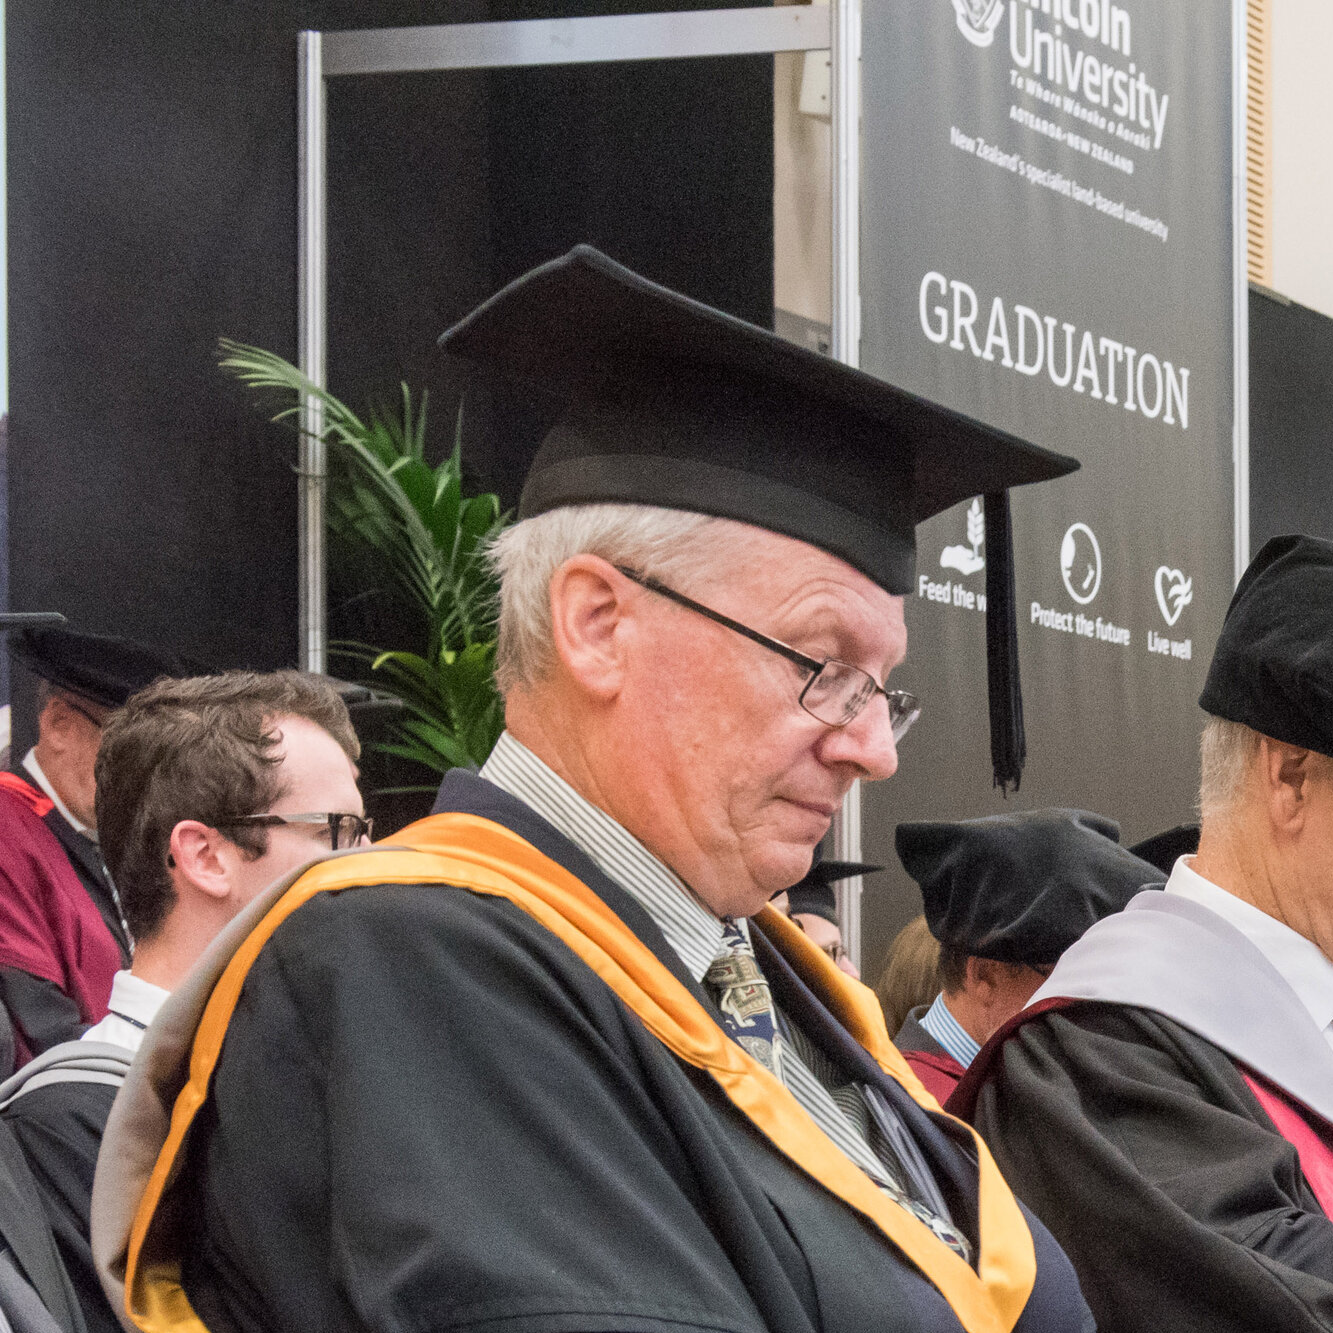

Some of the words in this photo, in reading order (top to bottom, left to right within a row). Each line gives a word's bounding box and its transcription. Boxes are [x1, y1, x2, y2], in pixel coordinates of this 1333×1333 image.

[1018, 0, 1131, 57] coln
[1010, 0, 1169, 150] University
[950, 125, 976, 153] New
[1090, 143, 1134, 175] ZEALAND
[919, 271, 1190, 429] GRADUATION
[919, 575, 951, 605] Feed
[953, 583, 974, 610] the
[1031, 602, 1073, 635] Protect
[1075, 612, 1095, 637] the
[1095, 618, 1131, 646] future
[1147, 631, 1169, 655] Live
[1170, 638, 1192, 660] well
